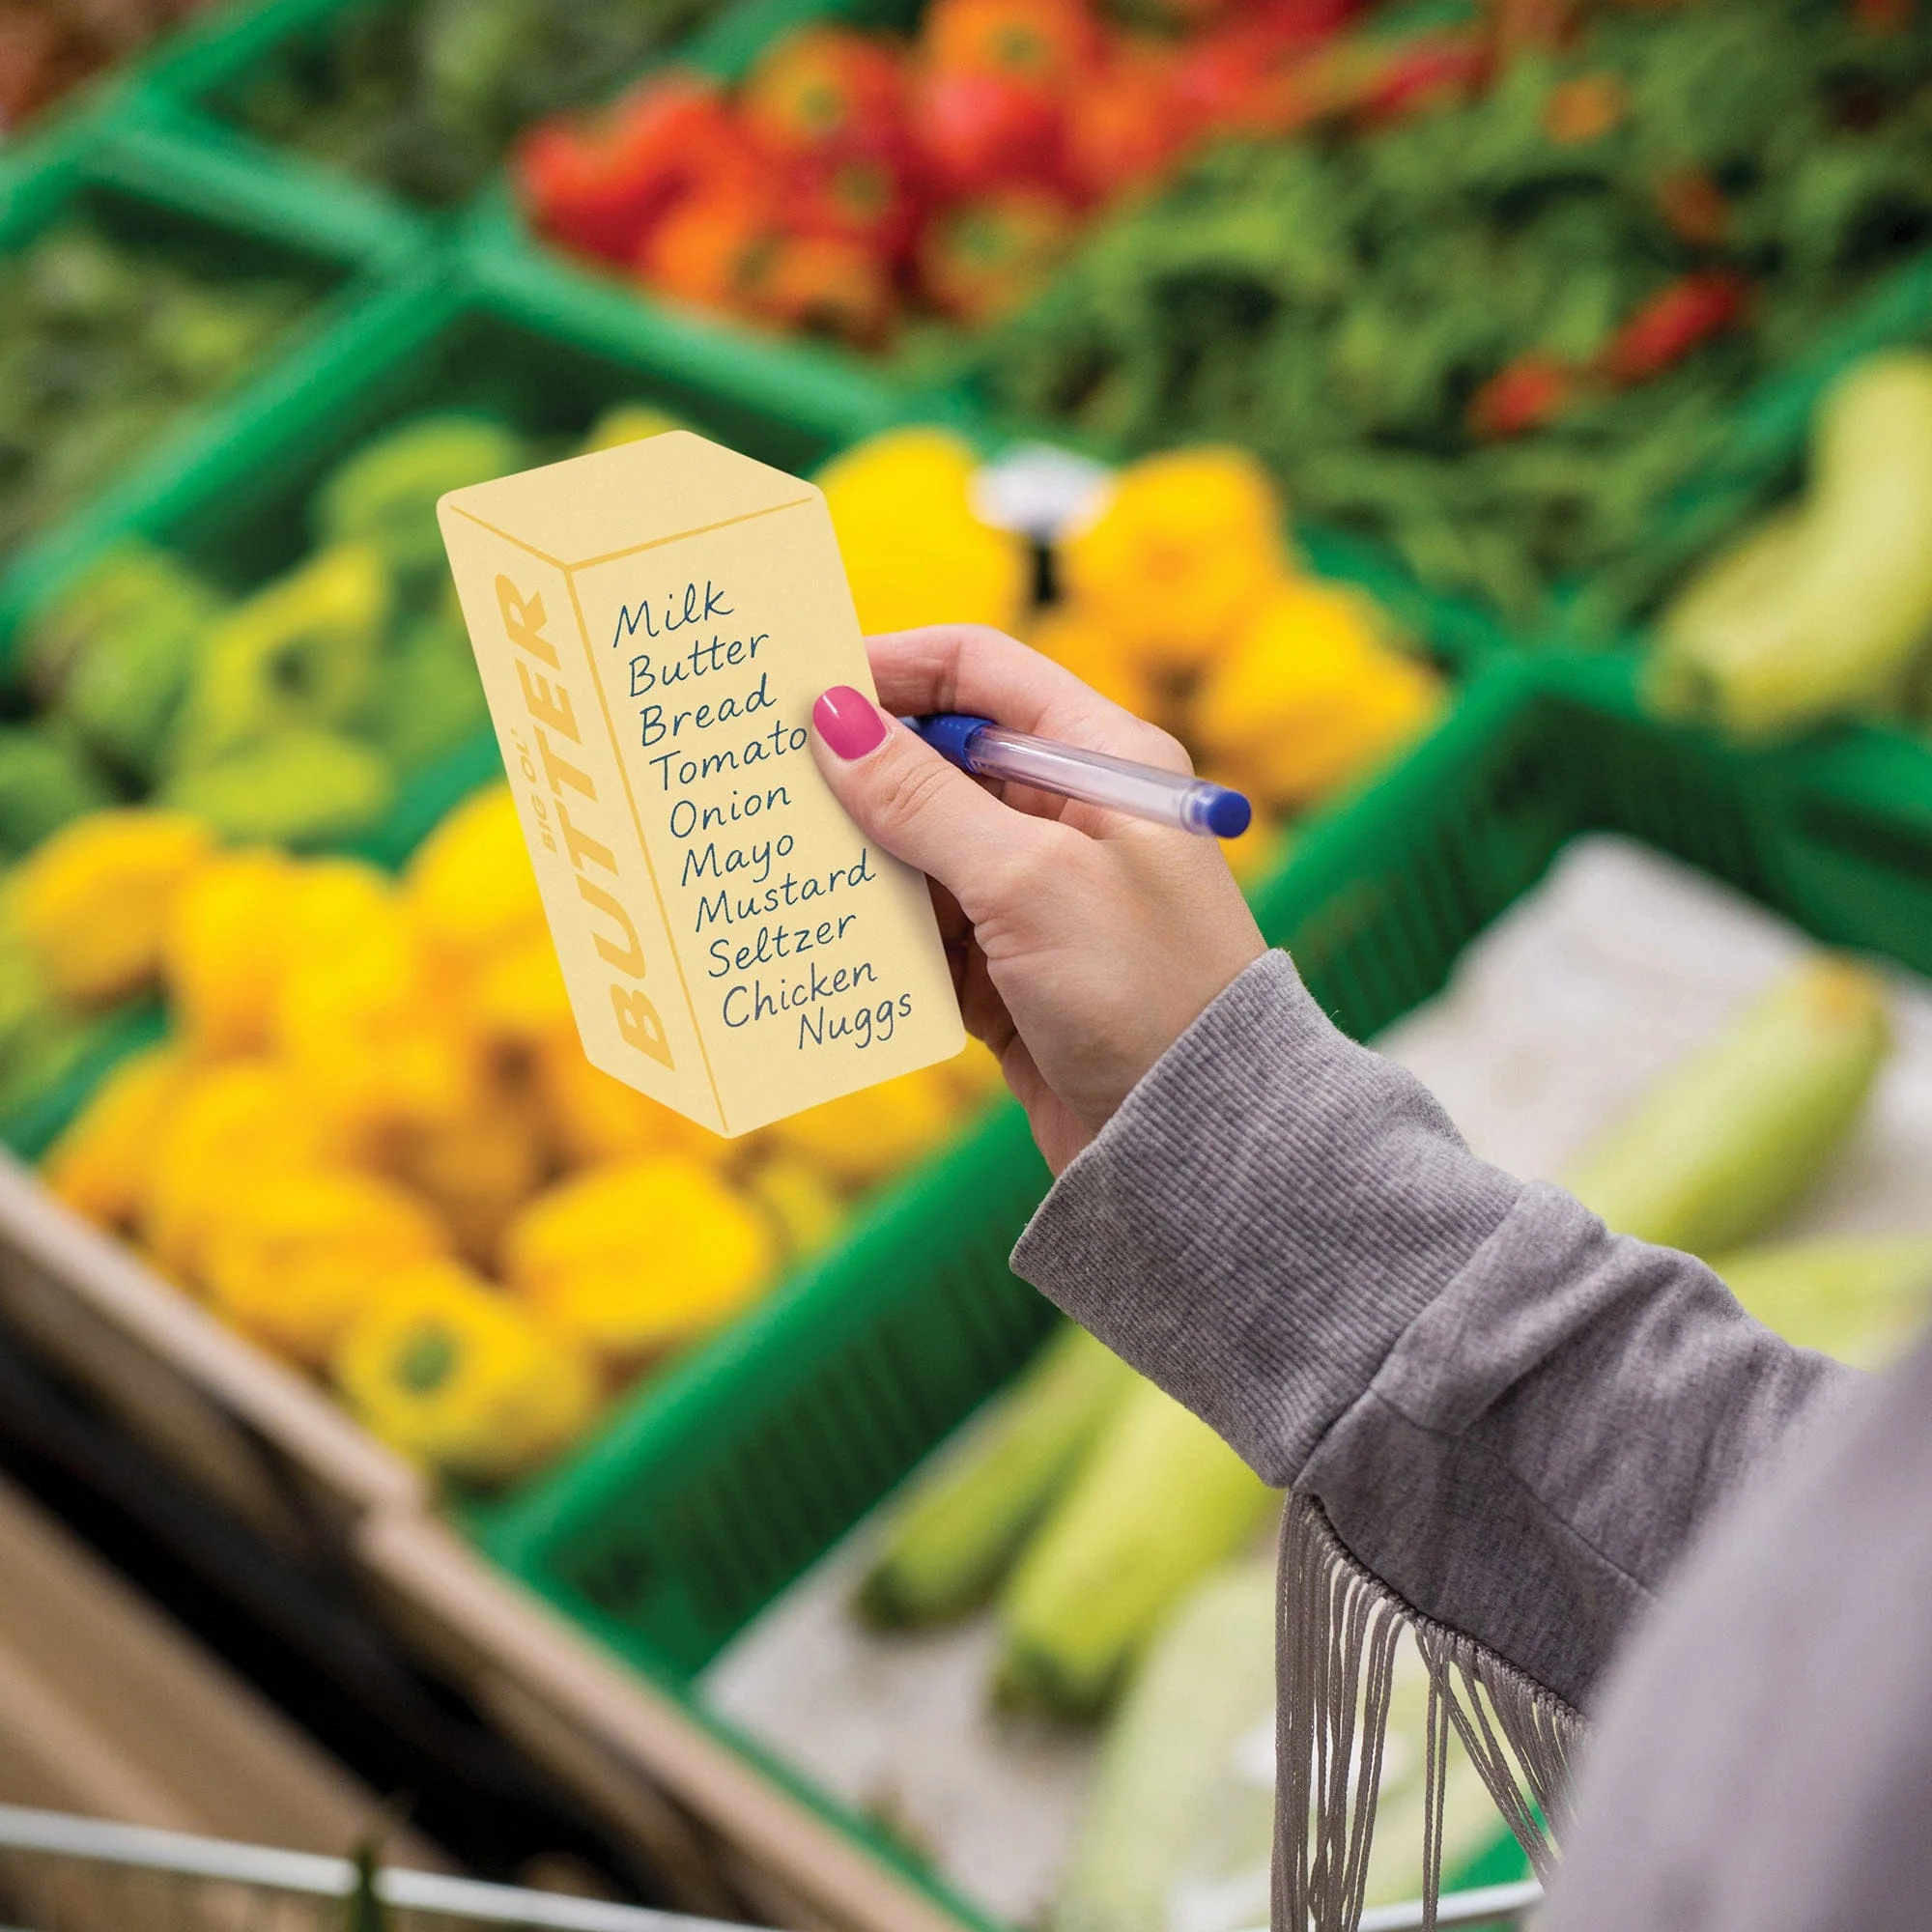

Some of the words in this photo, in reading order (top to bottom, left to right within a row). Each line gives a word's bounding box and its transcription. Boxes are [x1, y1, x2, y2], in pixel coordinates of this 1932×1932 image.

[613, 580, 734, 647] Milk
[629, 635, 769, 696] Butter
[640, 672, 777, 747] Bread
[649, 721, 807, 790] Tomato
[495, 573, 676, 1072] BUTTER
[530, 793, 557, 853] BIG
[670, 787, 791, 838] Onion
[682, 836, 793, 886] Mayo
[696, 848, 875, 932] Mustard
[709, 915, 856, 977] Seltzer
[724, 963, 877, 1027] Chicken
[799, 994, 911, 1049] Nuggs
